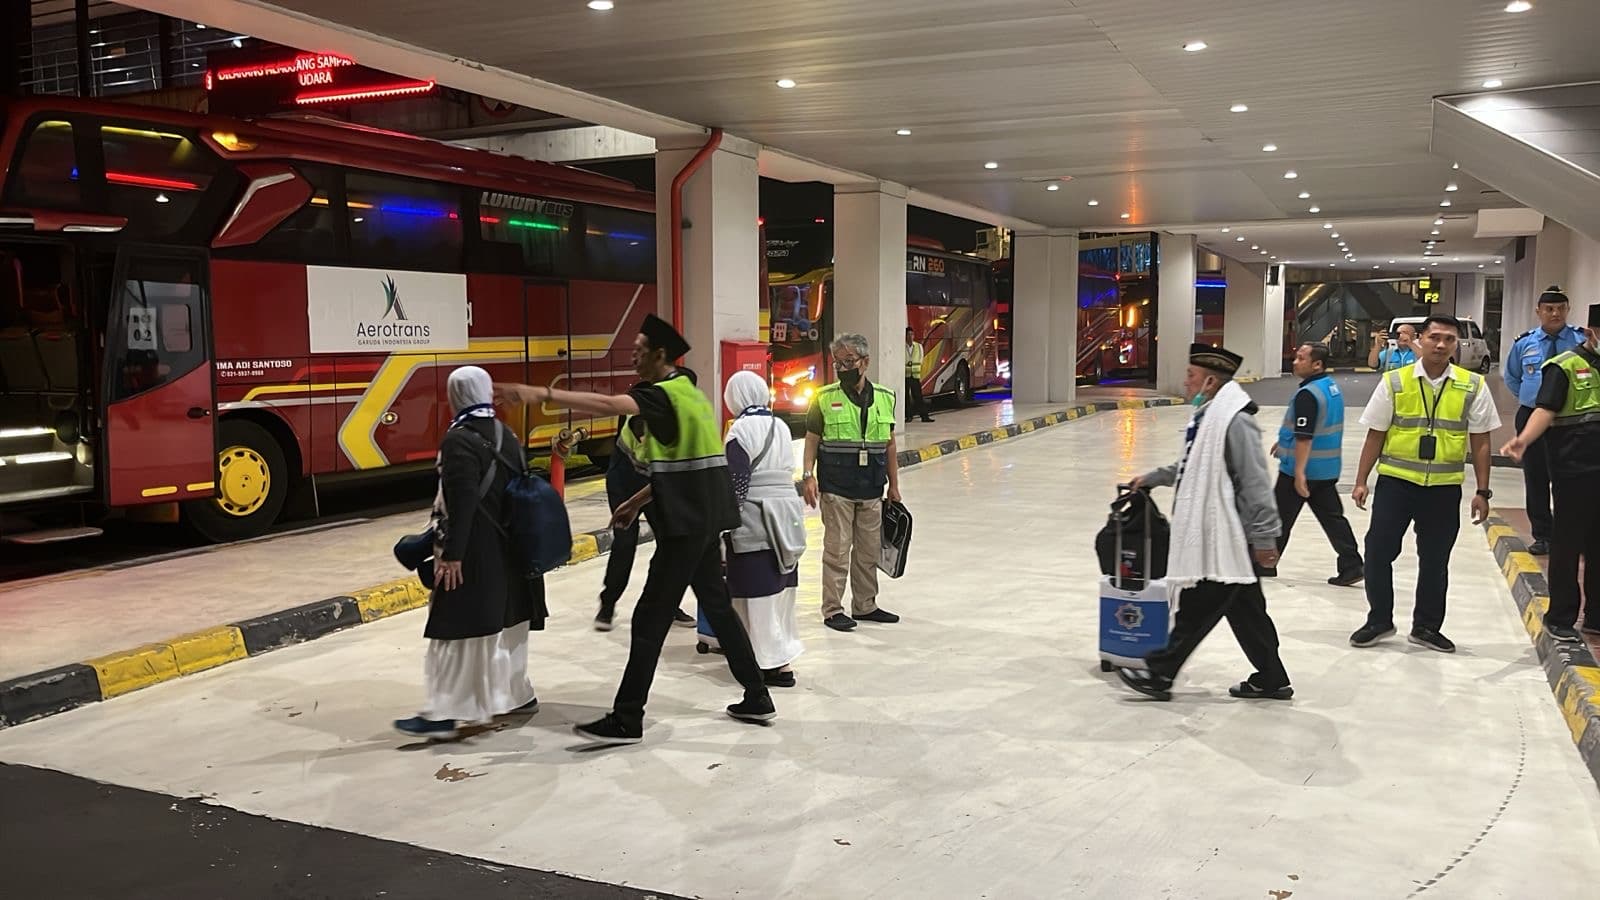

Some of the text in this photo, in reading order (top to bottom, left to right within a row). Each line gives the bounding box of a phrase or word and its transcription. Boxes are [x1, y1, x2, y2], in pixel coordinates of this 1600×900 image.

[299, 71, 333, 86] UDARA
[913, 255, 926, 272] RN
[1424, 292, 1440, 304] F2
[356, 322, 430, 337] Aerotrans
[235, 361, 250, 369] ADI
[252, 359, 292, 369] SANTOSO
